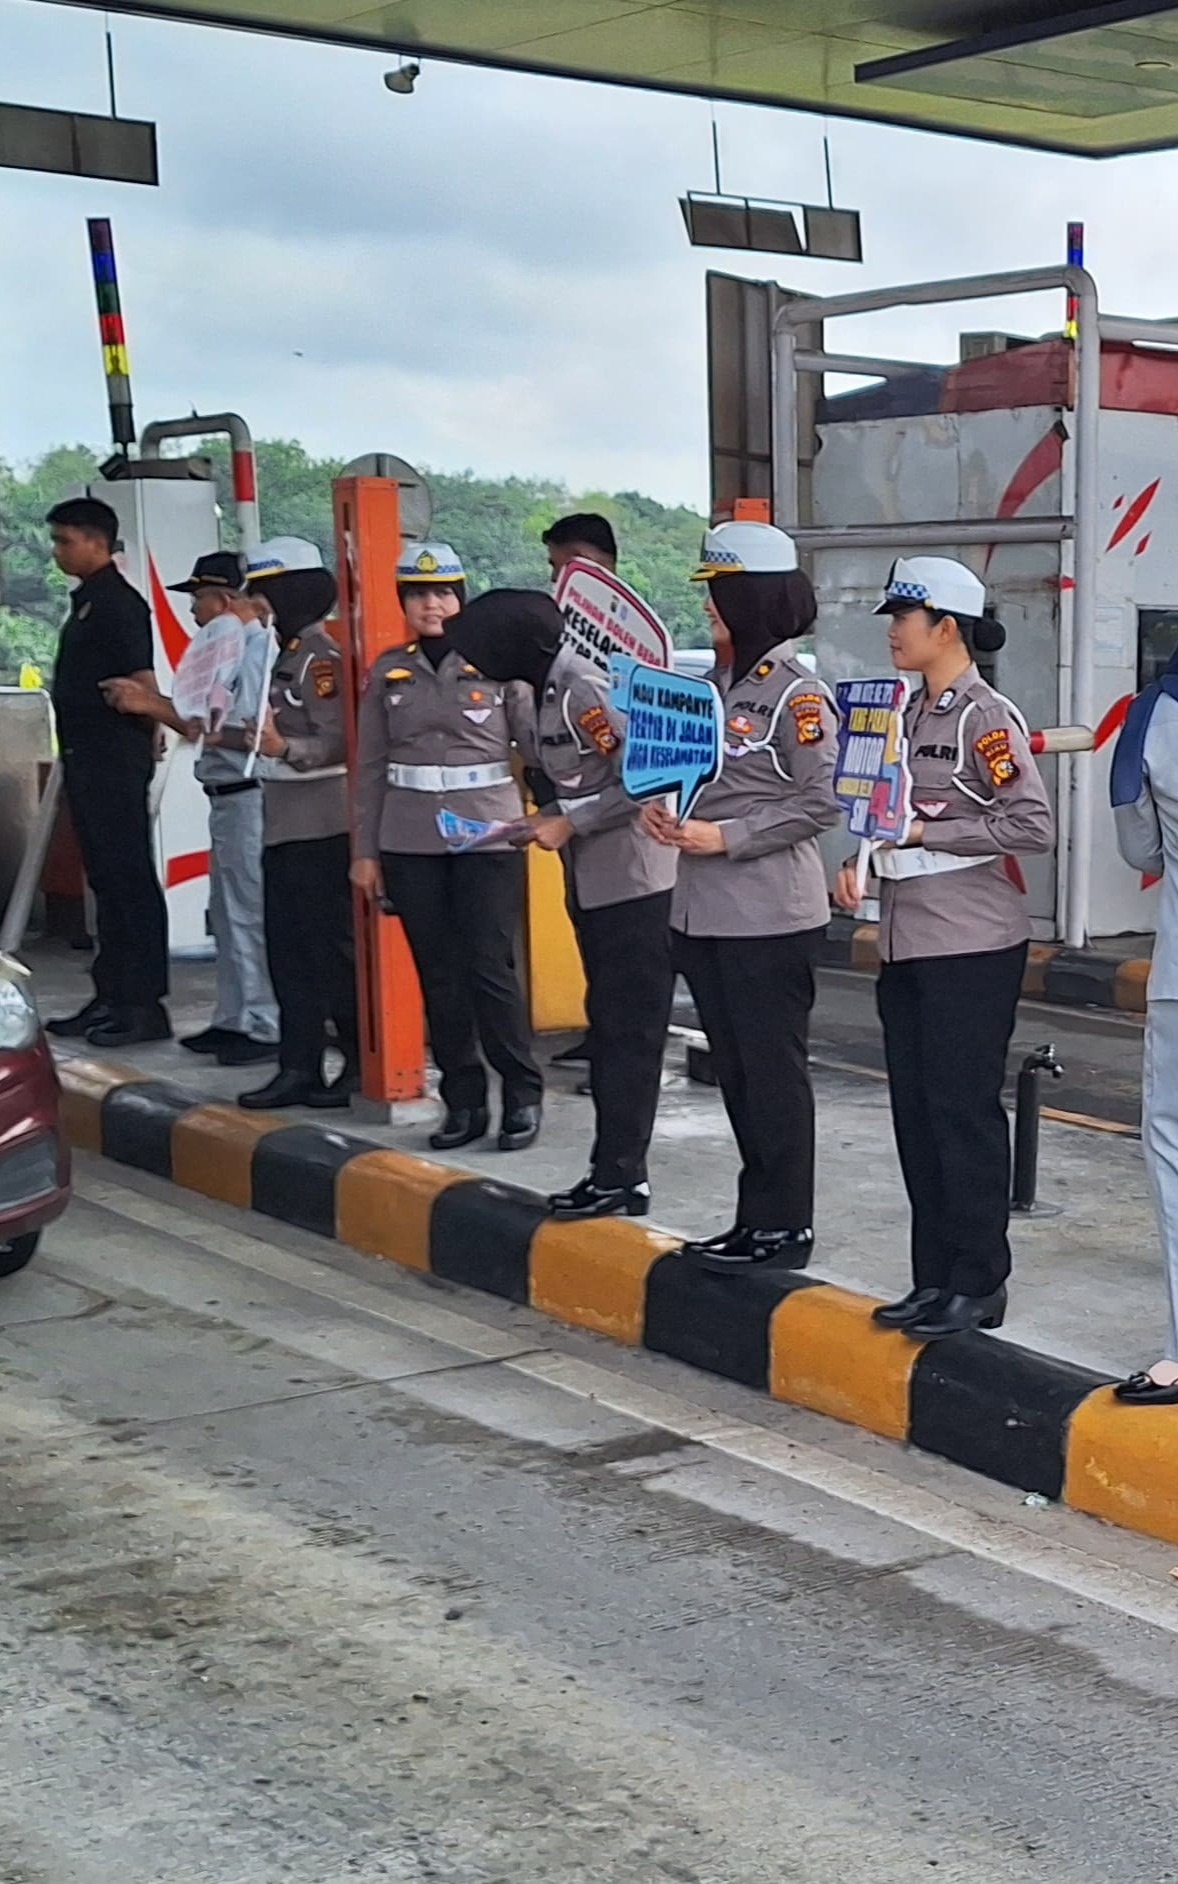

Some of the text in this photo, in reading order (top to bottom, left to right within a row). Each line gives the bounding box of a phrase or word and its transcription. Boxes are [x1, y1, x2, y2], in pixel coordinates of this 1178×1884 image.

[633, 683, 713, 719] MAU KAMPANYE
[787, 694, 822, 708] POLDA
[630, 707, 664, 742] TERTIB
[665, 716, 677, 742] DI
[679, 719, 712, 745] JALAN
[976, 730, 1006, 751] POLDA
[985, 743, 1007, 758] RIAU
[650, 745, 713, 769] KESELAMATAN
[843, 735, 885, 777] MOTOR
[915, 744, 959, 761] POLRI
